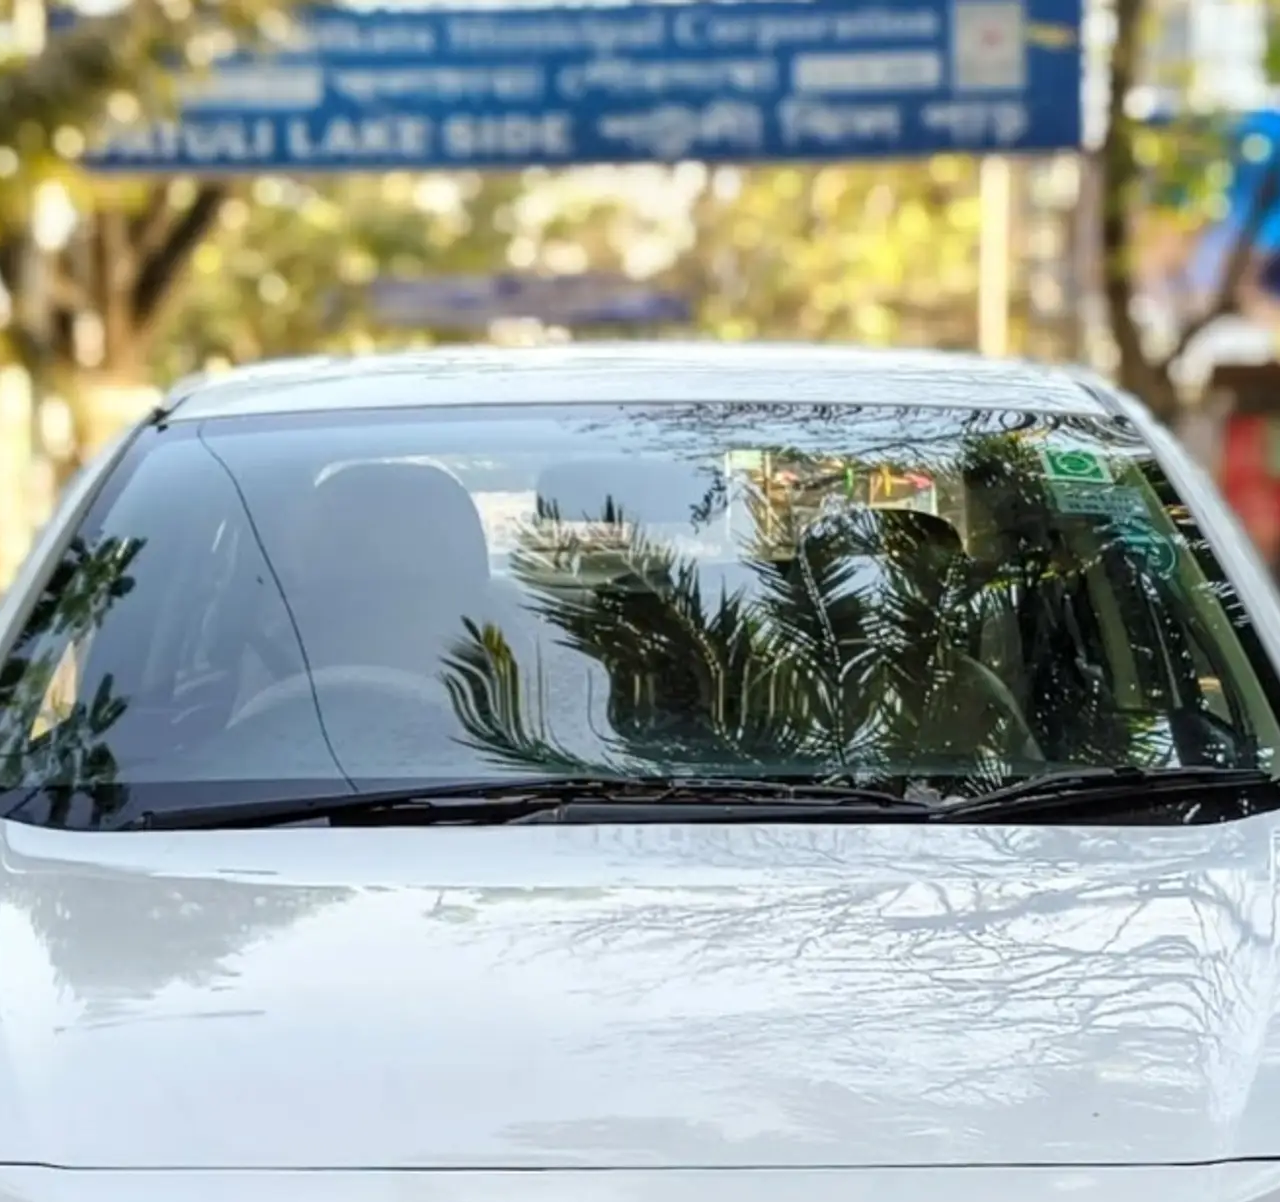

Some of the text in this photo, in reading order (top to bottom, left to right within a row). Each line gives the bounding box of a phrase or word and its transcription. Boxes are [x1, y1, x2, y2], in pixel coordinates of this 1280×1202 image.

[673, 8, 938, 48] Corporation
[286, 112, 426, 158] LAKE
[441, 112, 574, 156] SIDE
